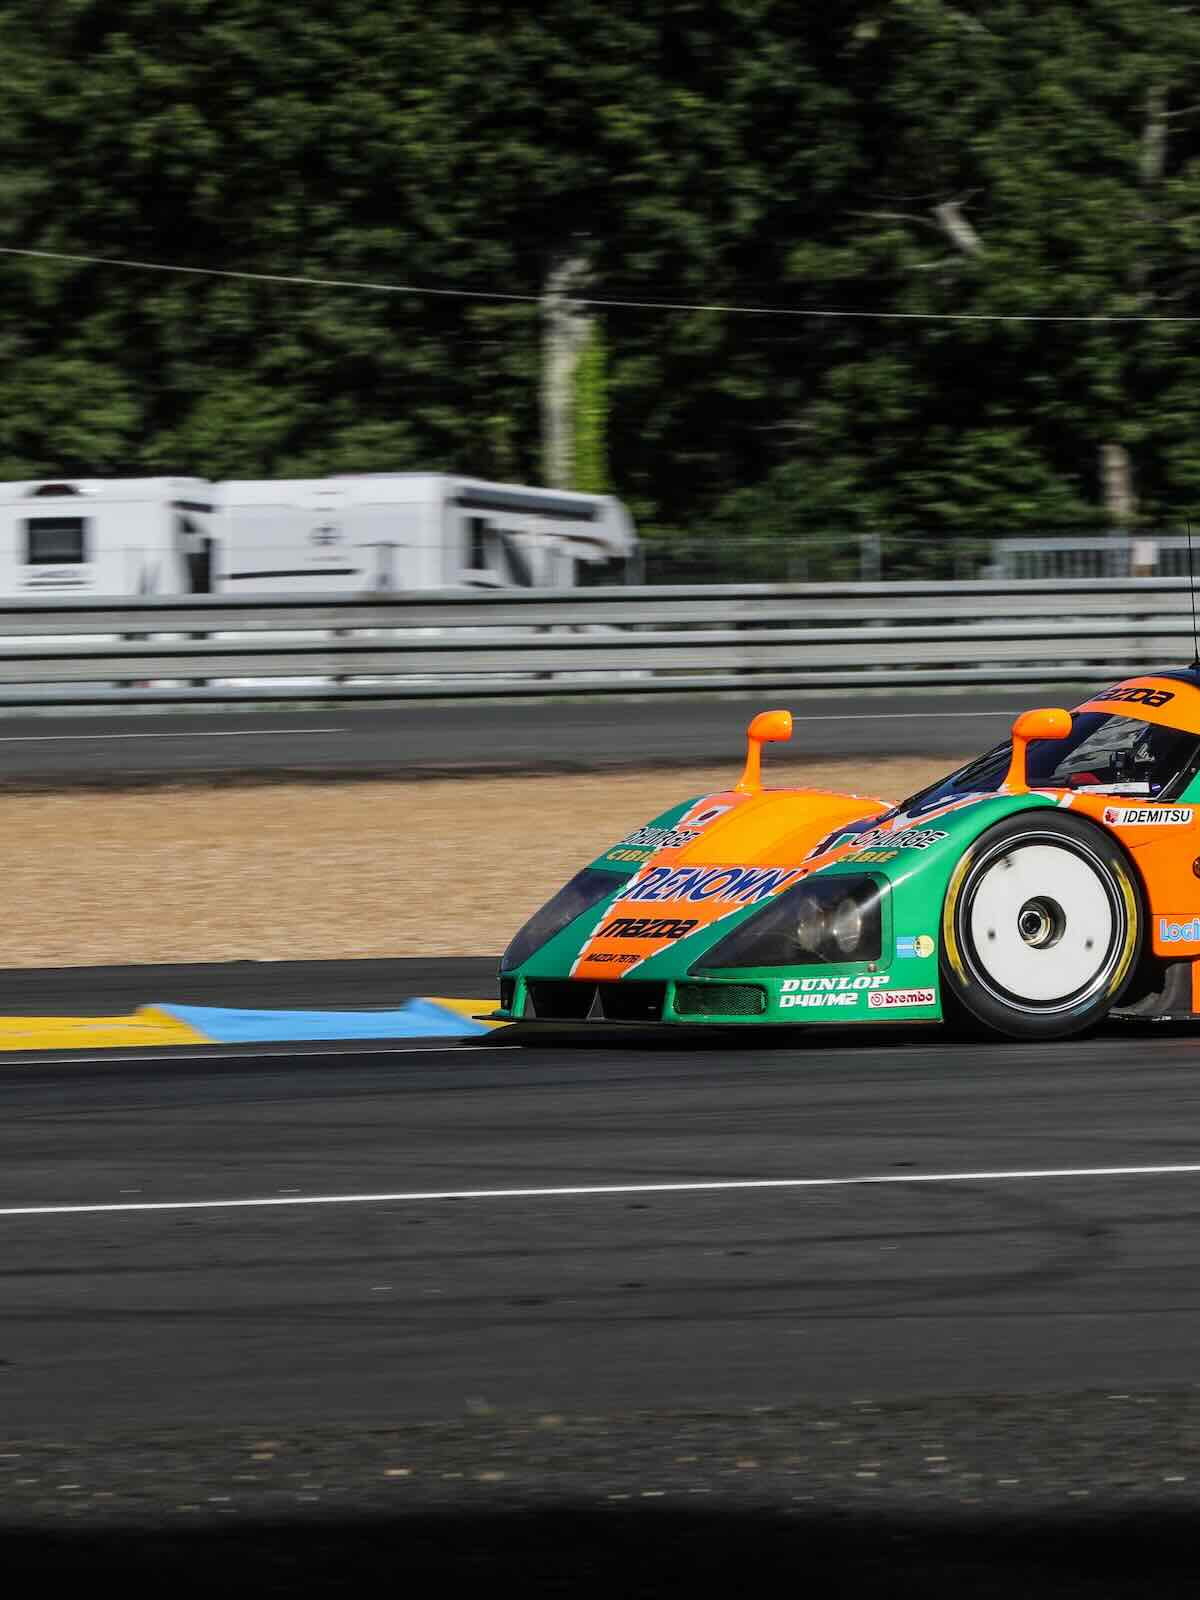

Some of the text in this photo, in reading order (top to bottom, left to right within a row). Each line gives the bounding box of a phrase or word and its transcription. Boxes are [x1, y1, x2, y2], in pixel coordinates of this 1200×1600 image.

[1123, 810, 1191, 823] IDEMITSU
[613, 866, 798, 902] RENOWN
[596, 918, 698, 939] mazda
[780, 976, 890, 992] DUNLOP
[885, 991, 934, 1005] brembo
